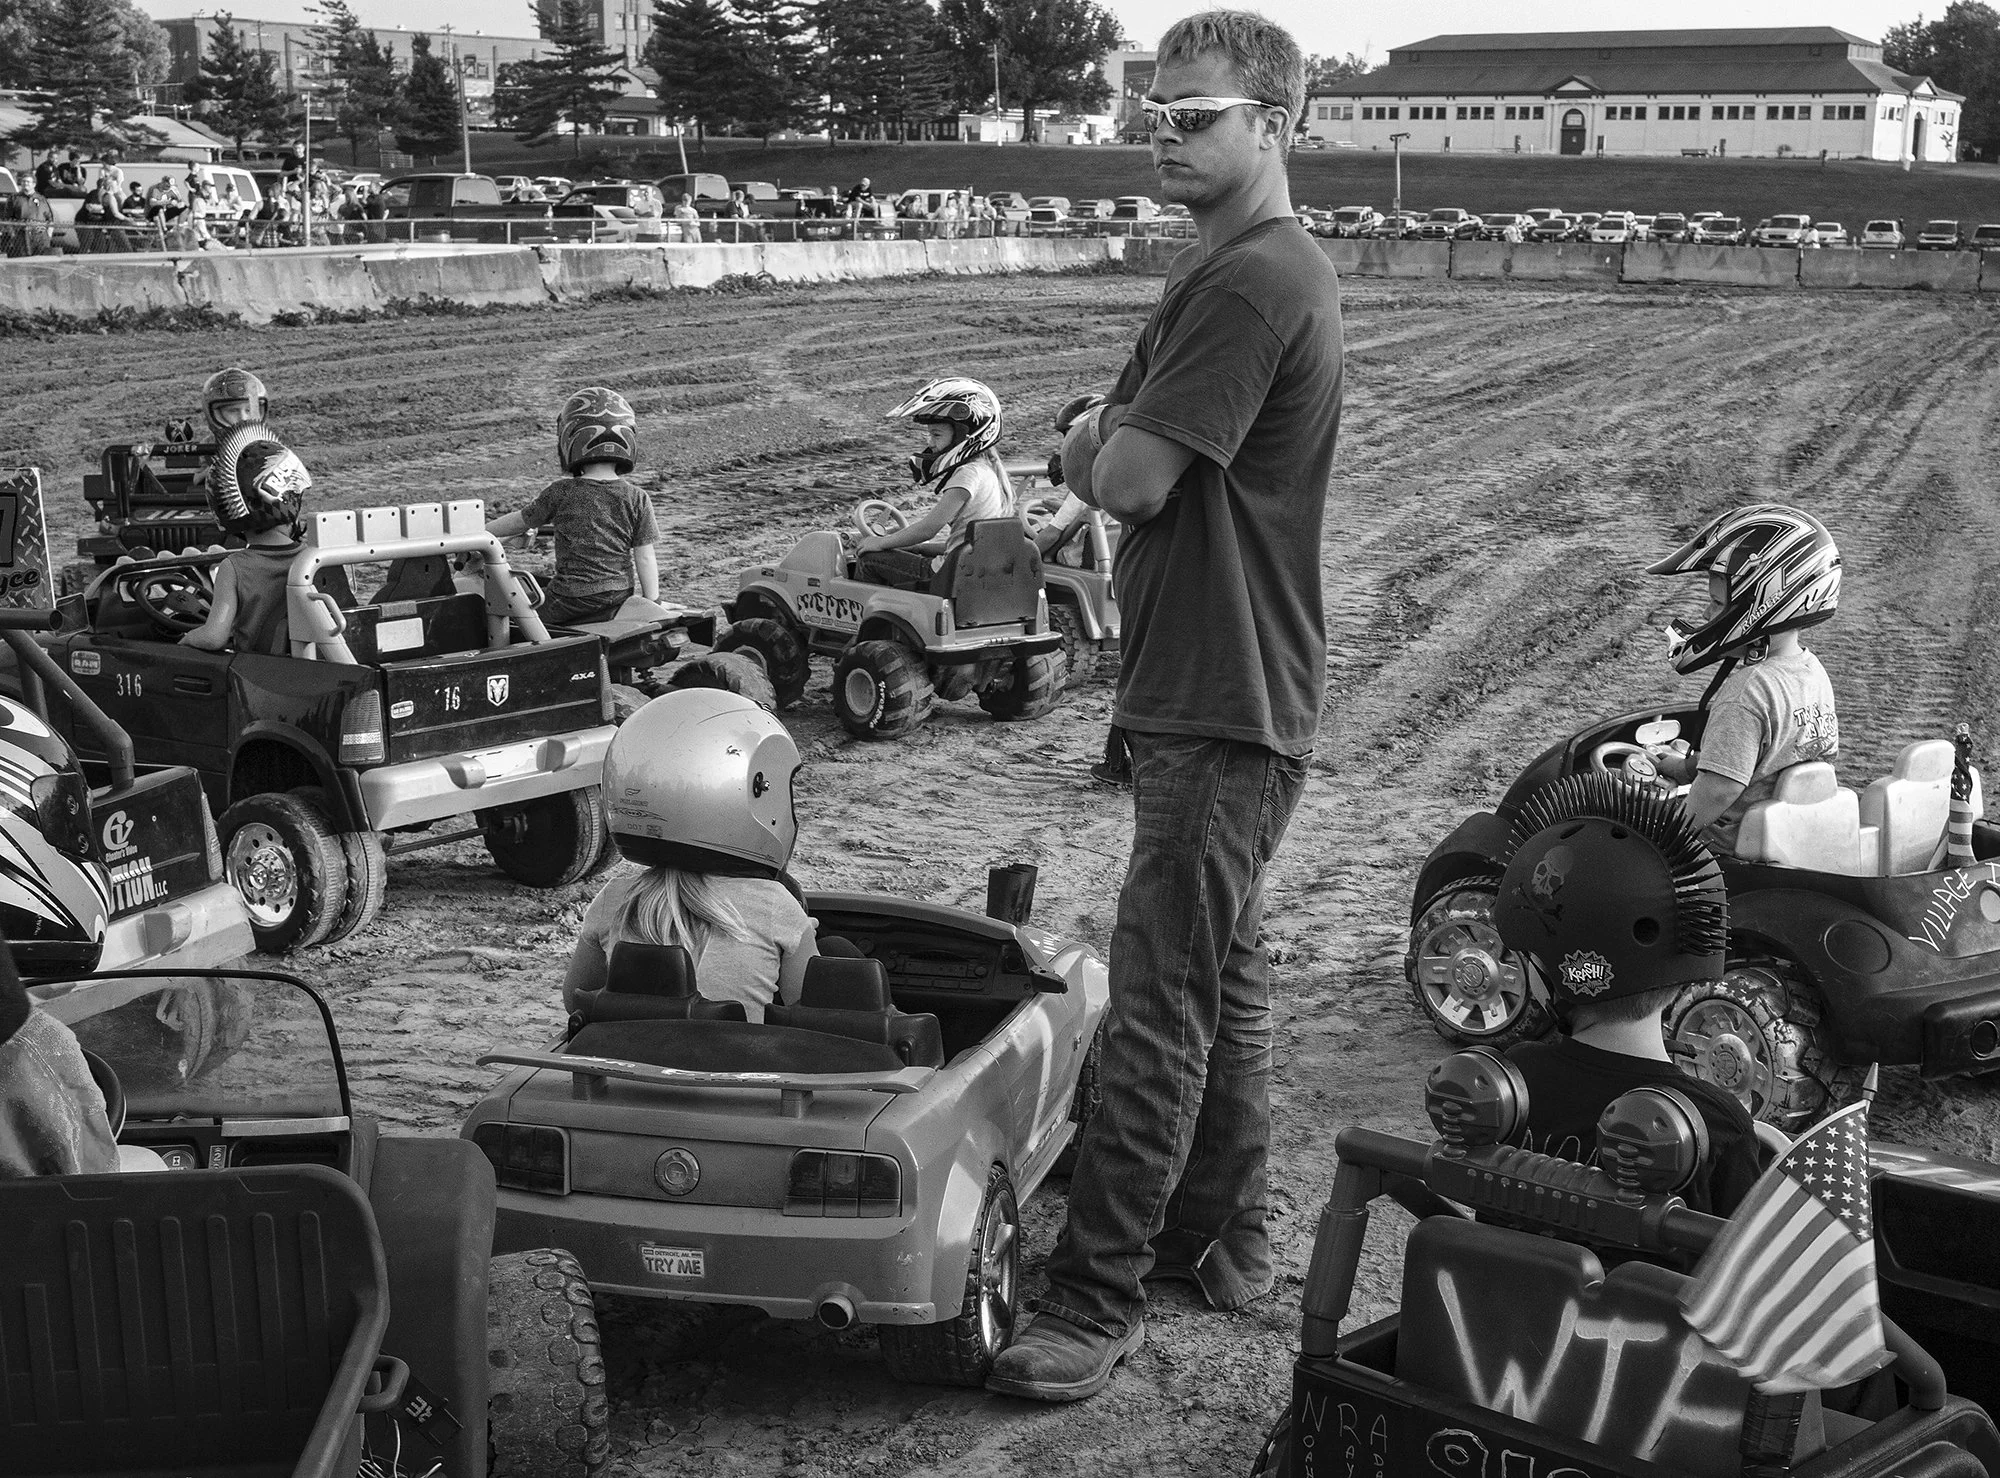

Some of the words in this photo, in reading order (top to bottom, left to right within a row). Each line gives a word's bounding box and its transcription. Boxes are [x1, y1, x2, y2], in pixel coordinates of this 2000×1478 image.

[163, 444, 198, 454] JOKER
[116, 673, 142, 697] 316
[154, 880, 169, 898] LLC
[1908, 867, 1977, 952] VILLAGE
[1568, 962, 1604, 983] KRASH!
[645, 1256, 674, 1273] TRY
[677, 1258, 701, 1275] ME
